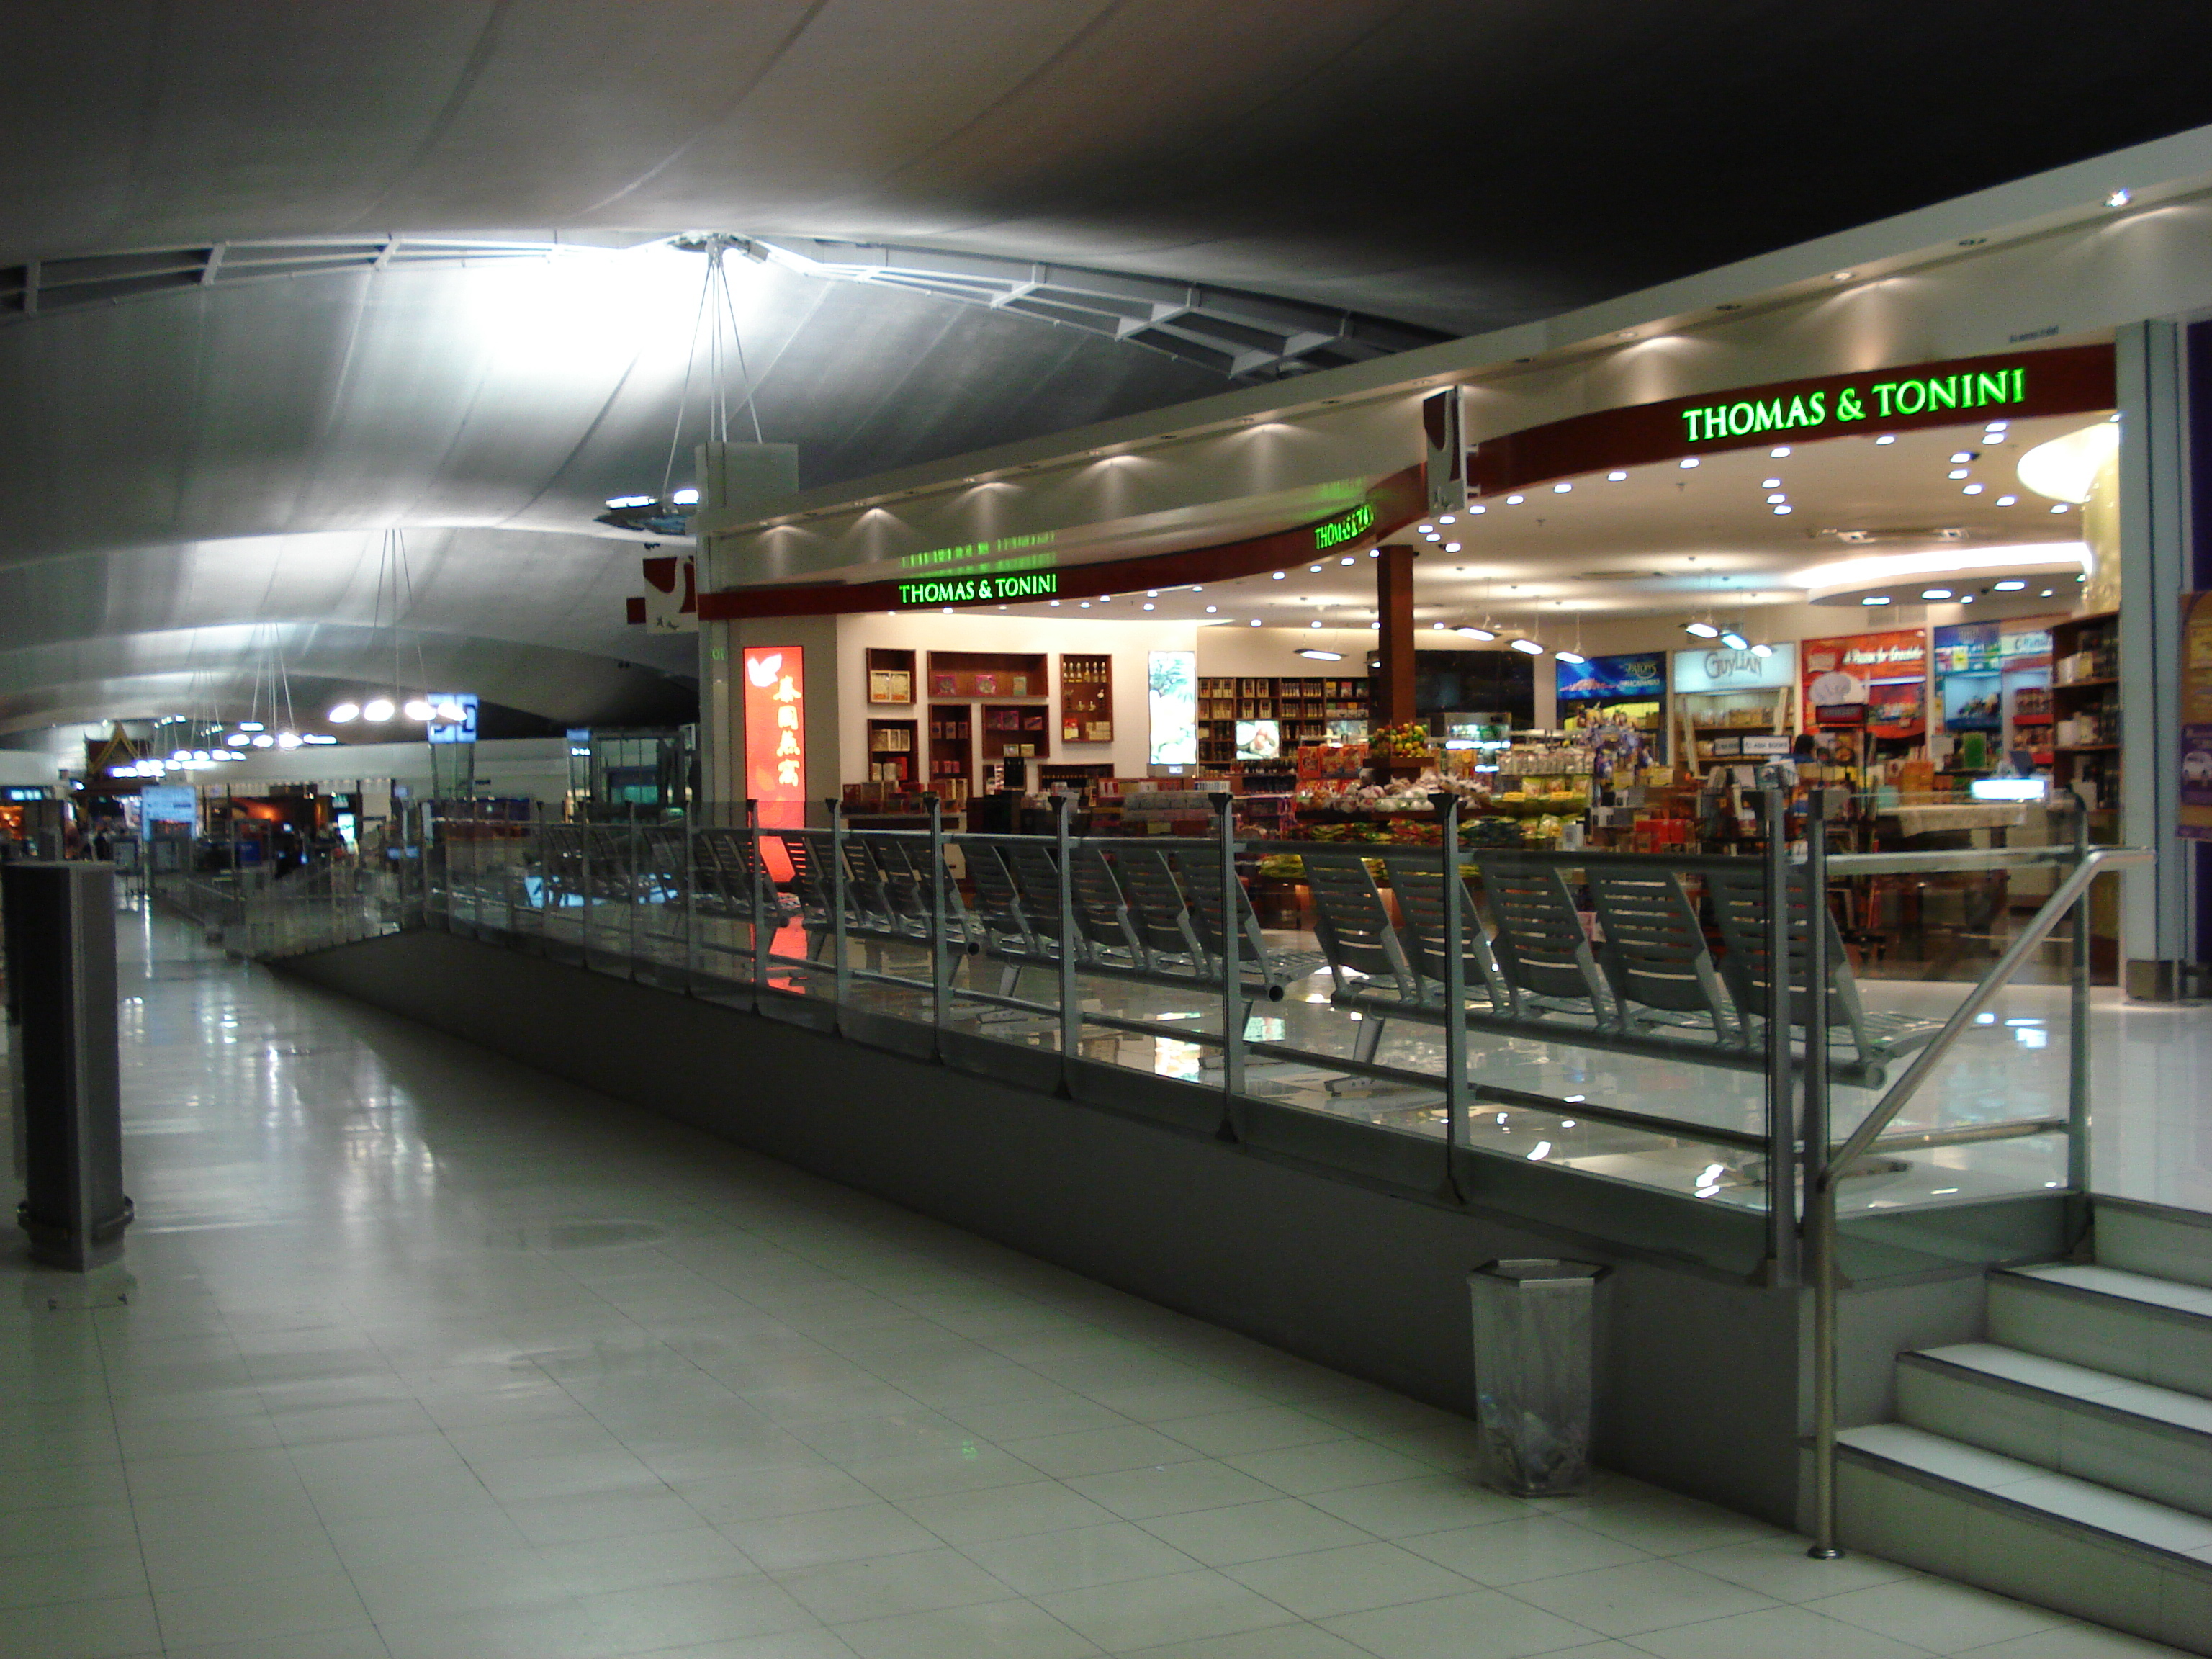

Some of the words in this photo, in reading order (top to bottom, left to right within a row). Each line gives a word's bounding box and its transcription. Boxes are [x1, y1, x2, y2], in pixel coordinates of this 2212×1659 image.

[1682, 391, 1825, 442] THOMAS
[1836, 387, 1866, 422] &
[1871, 367, 2026, 418] TONINI
[898, 580, 975, 603] THOMAS
[978, 579, 993, 599] &
[994, 574, 1057, 598] TONINI
